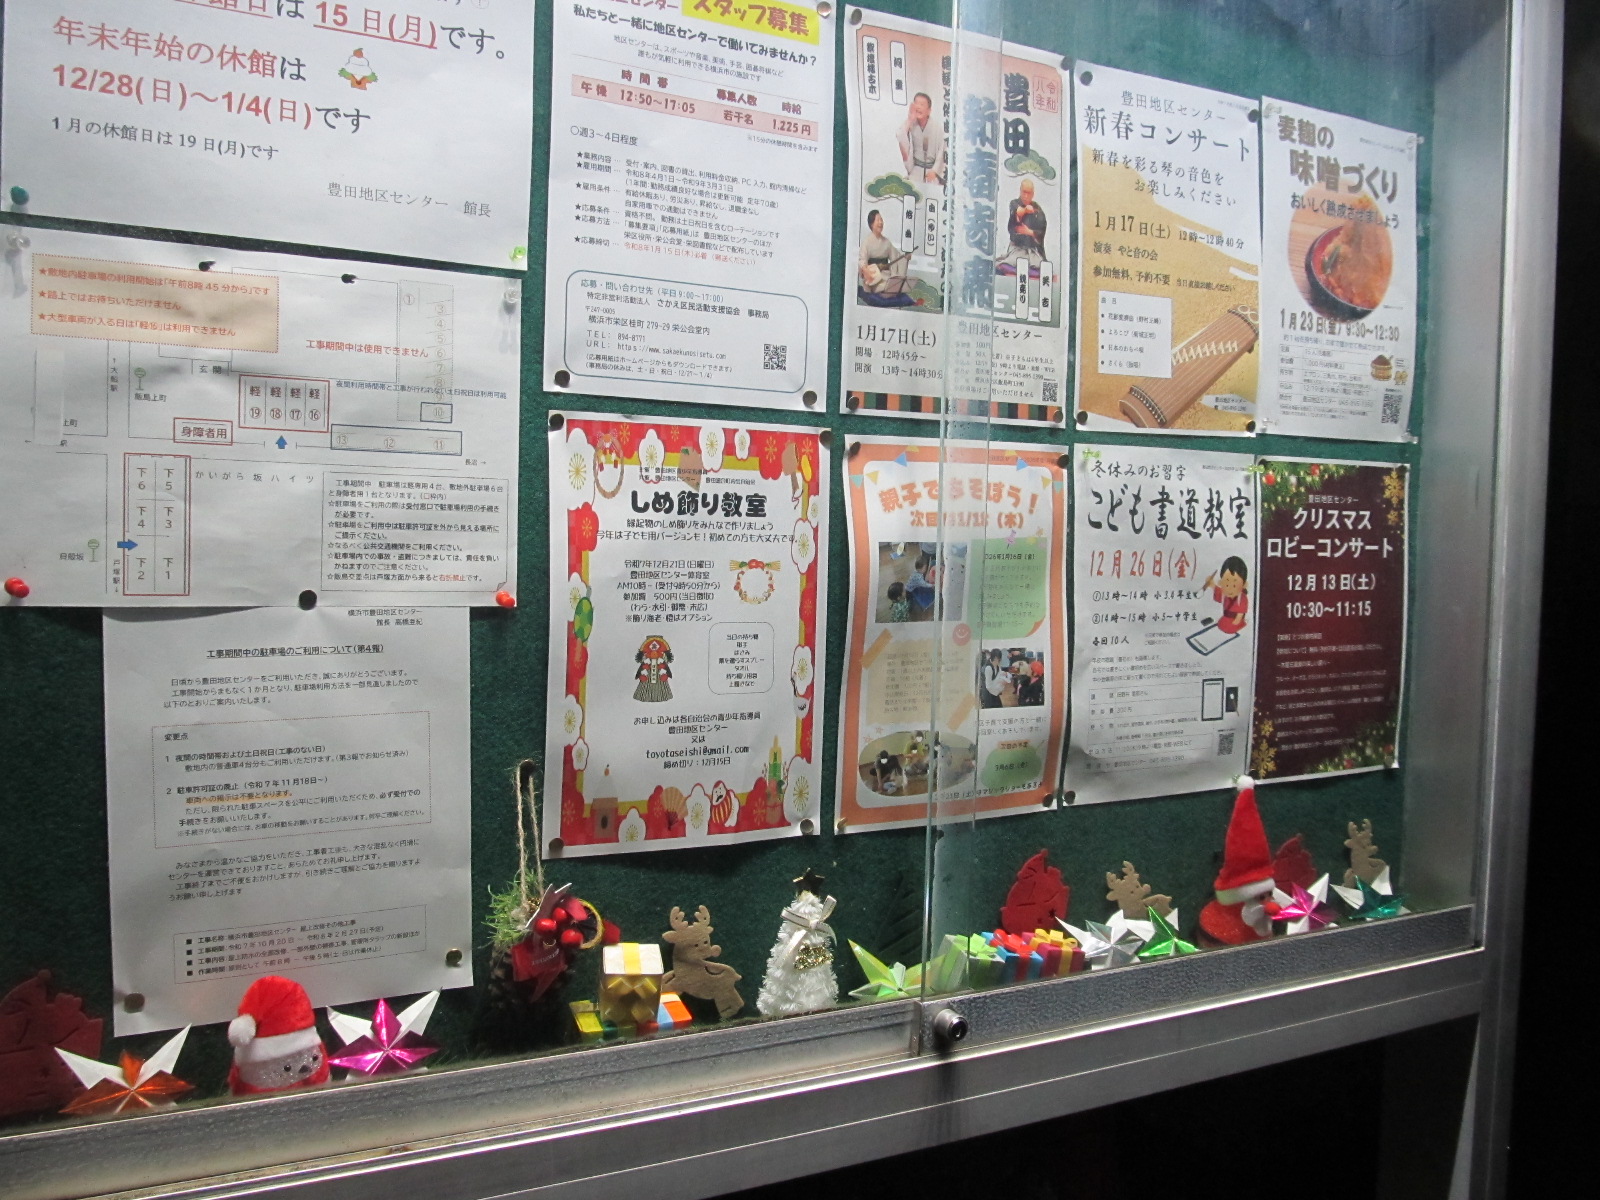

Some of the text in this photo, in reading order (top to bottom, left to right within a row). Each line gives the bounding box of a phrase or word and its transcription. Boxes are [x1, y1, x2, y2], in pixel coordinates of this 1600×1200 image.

[52, 15, 307, 83] 年末年始の休館は
[580, 81, 607, 98] 午後
[723, 110, 754, 125] 若干名
[717, 88, 758, 107] 募集人数
[782, 102, 802, 115] 時給
[1121, 90, 1226, 121] 豊田地区センター
[1083, 105, 1250, 162] 新春コンサート
[1092, 148, 1225, 186] 新春を彩る琴の音色を
[1289, 148, 1398, 204] 味噌づくり
[327, 181, 492, 219] 豊田地区センター 館長
[1134, 179, 1236, 206] お楽しみください
[181, 426, 228, 440] 身障者用
[1090, 460, 1187, 482] 冬休みのお習字
[630, 490, 768, 518] しめ飾り教室
[1087, 483, 1252, 540] こども書道教室
[1293, 506, 1372, 530] クリスマス
[1266, 535, 1394, 559] ロビーコンサート
